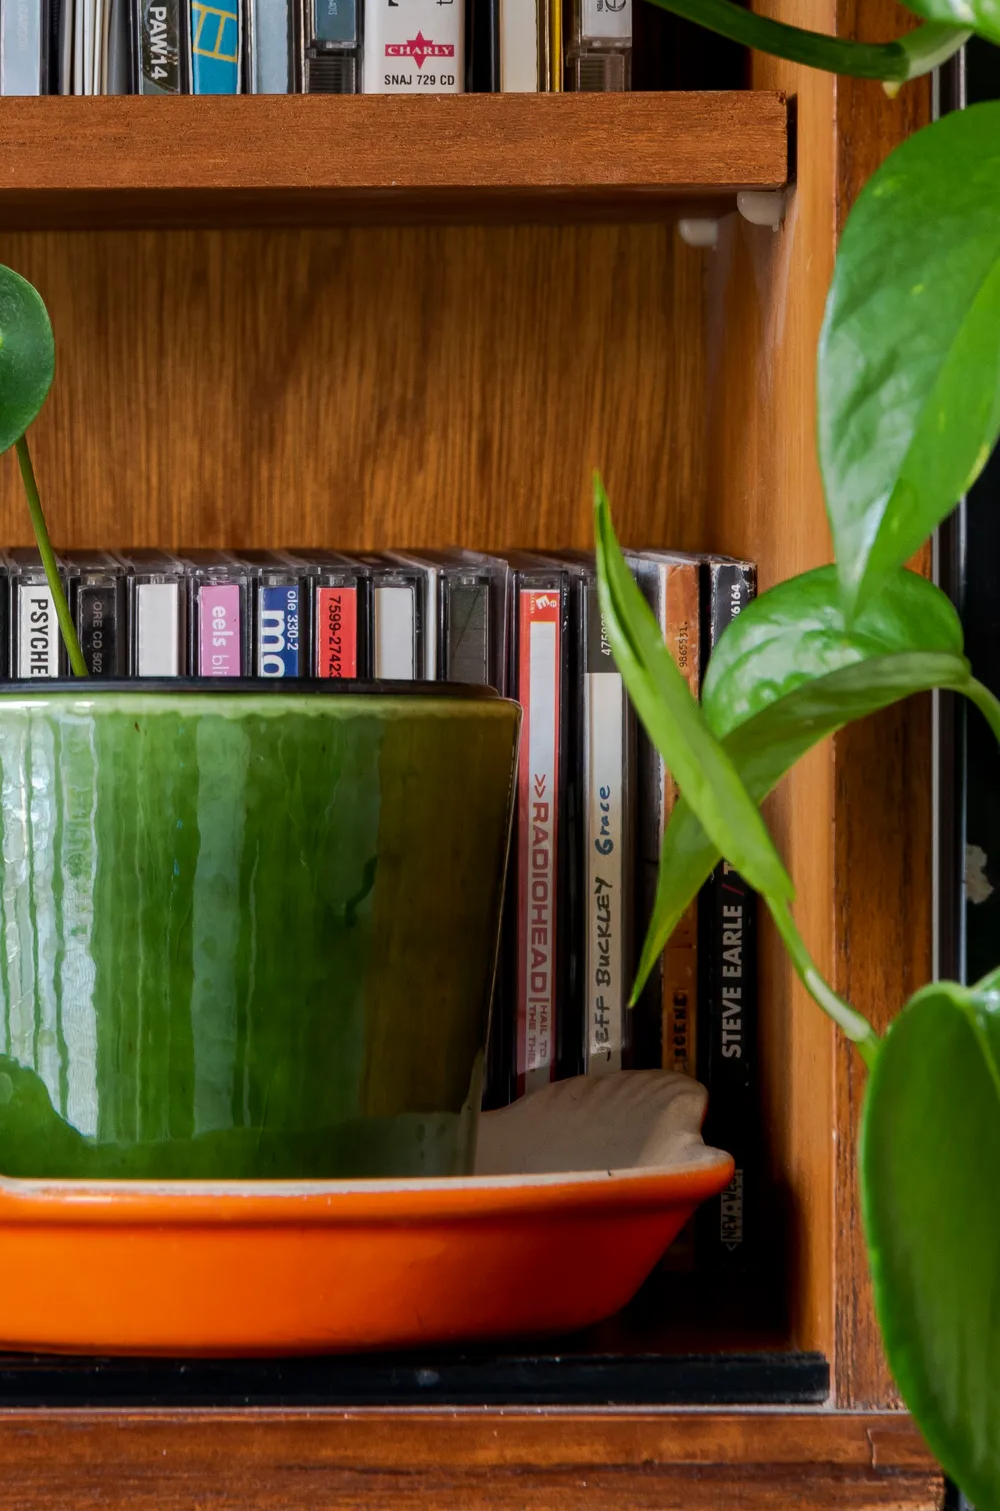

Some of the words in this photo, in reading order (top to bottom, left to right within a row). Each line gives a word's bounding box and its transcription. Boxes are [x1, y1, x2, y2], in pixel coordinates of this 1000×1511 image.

[149, 6, 168, 80] PAW14
[387, 46, 452, 55] CHARLY
[384, 74, 412, 85] SNAJ
[416, 74, 436, 85] 729
[440, 74, 455, 85] CD
[211, 605, 234, 647] eels
[286, 613, 298, 651] 330-2
[595, 785, 614, 856] Grace
[530, 802, 549, 994] RADIOHEAD
[594, 877, 613, 988] BUCKLEY
[722, 905, 743, 978] EARLE
[528, 1005, 538, 1030] THE
[539, 1005, 548, 1044] HAIL
[722, 987, 743, 1059] STEVE
